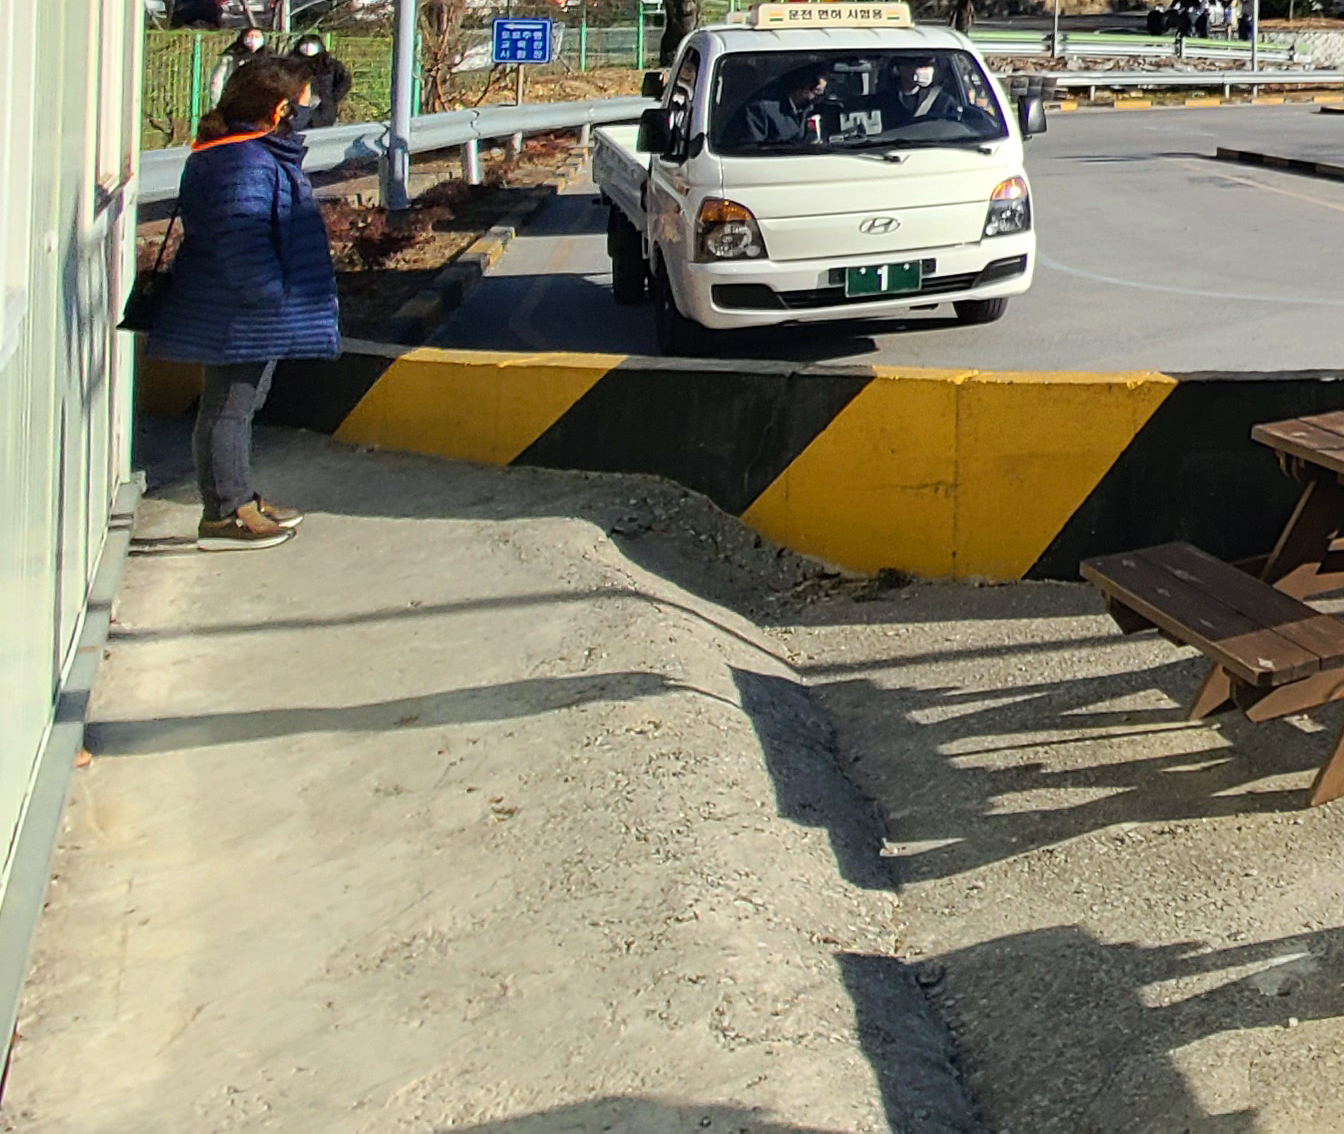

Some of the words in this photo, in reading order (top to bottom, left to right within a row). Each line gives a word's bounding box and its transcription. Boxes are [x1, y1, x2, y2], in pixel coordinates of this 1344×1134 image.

[789, 9, 812, 20] 운전
[848, 9, 882, 20] 시험용
[877, 265, 889, 291] 1
